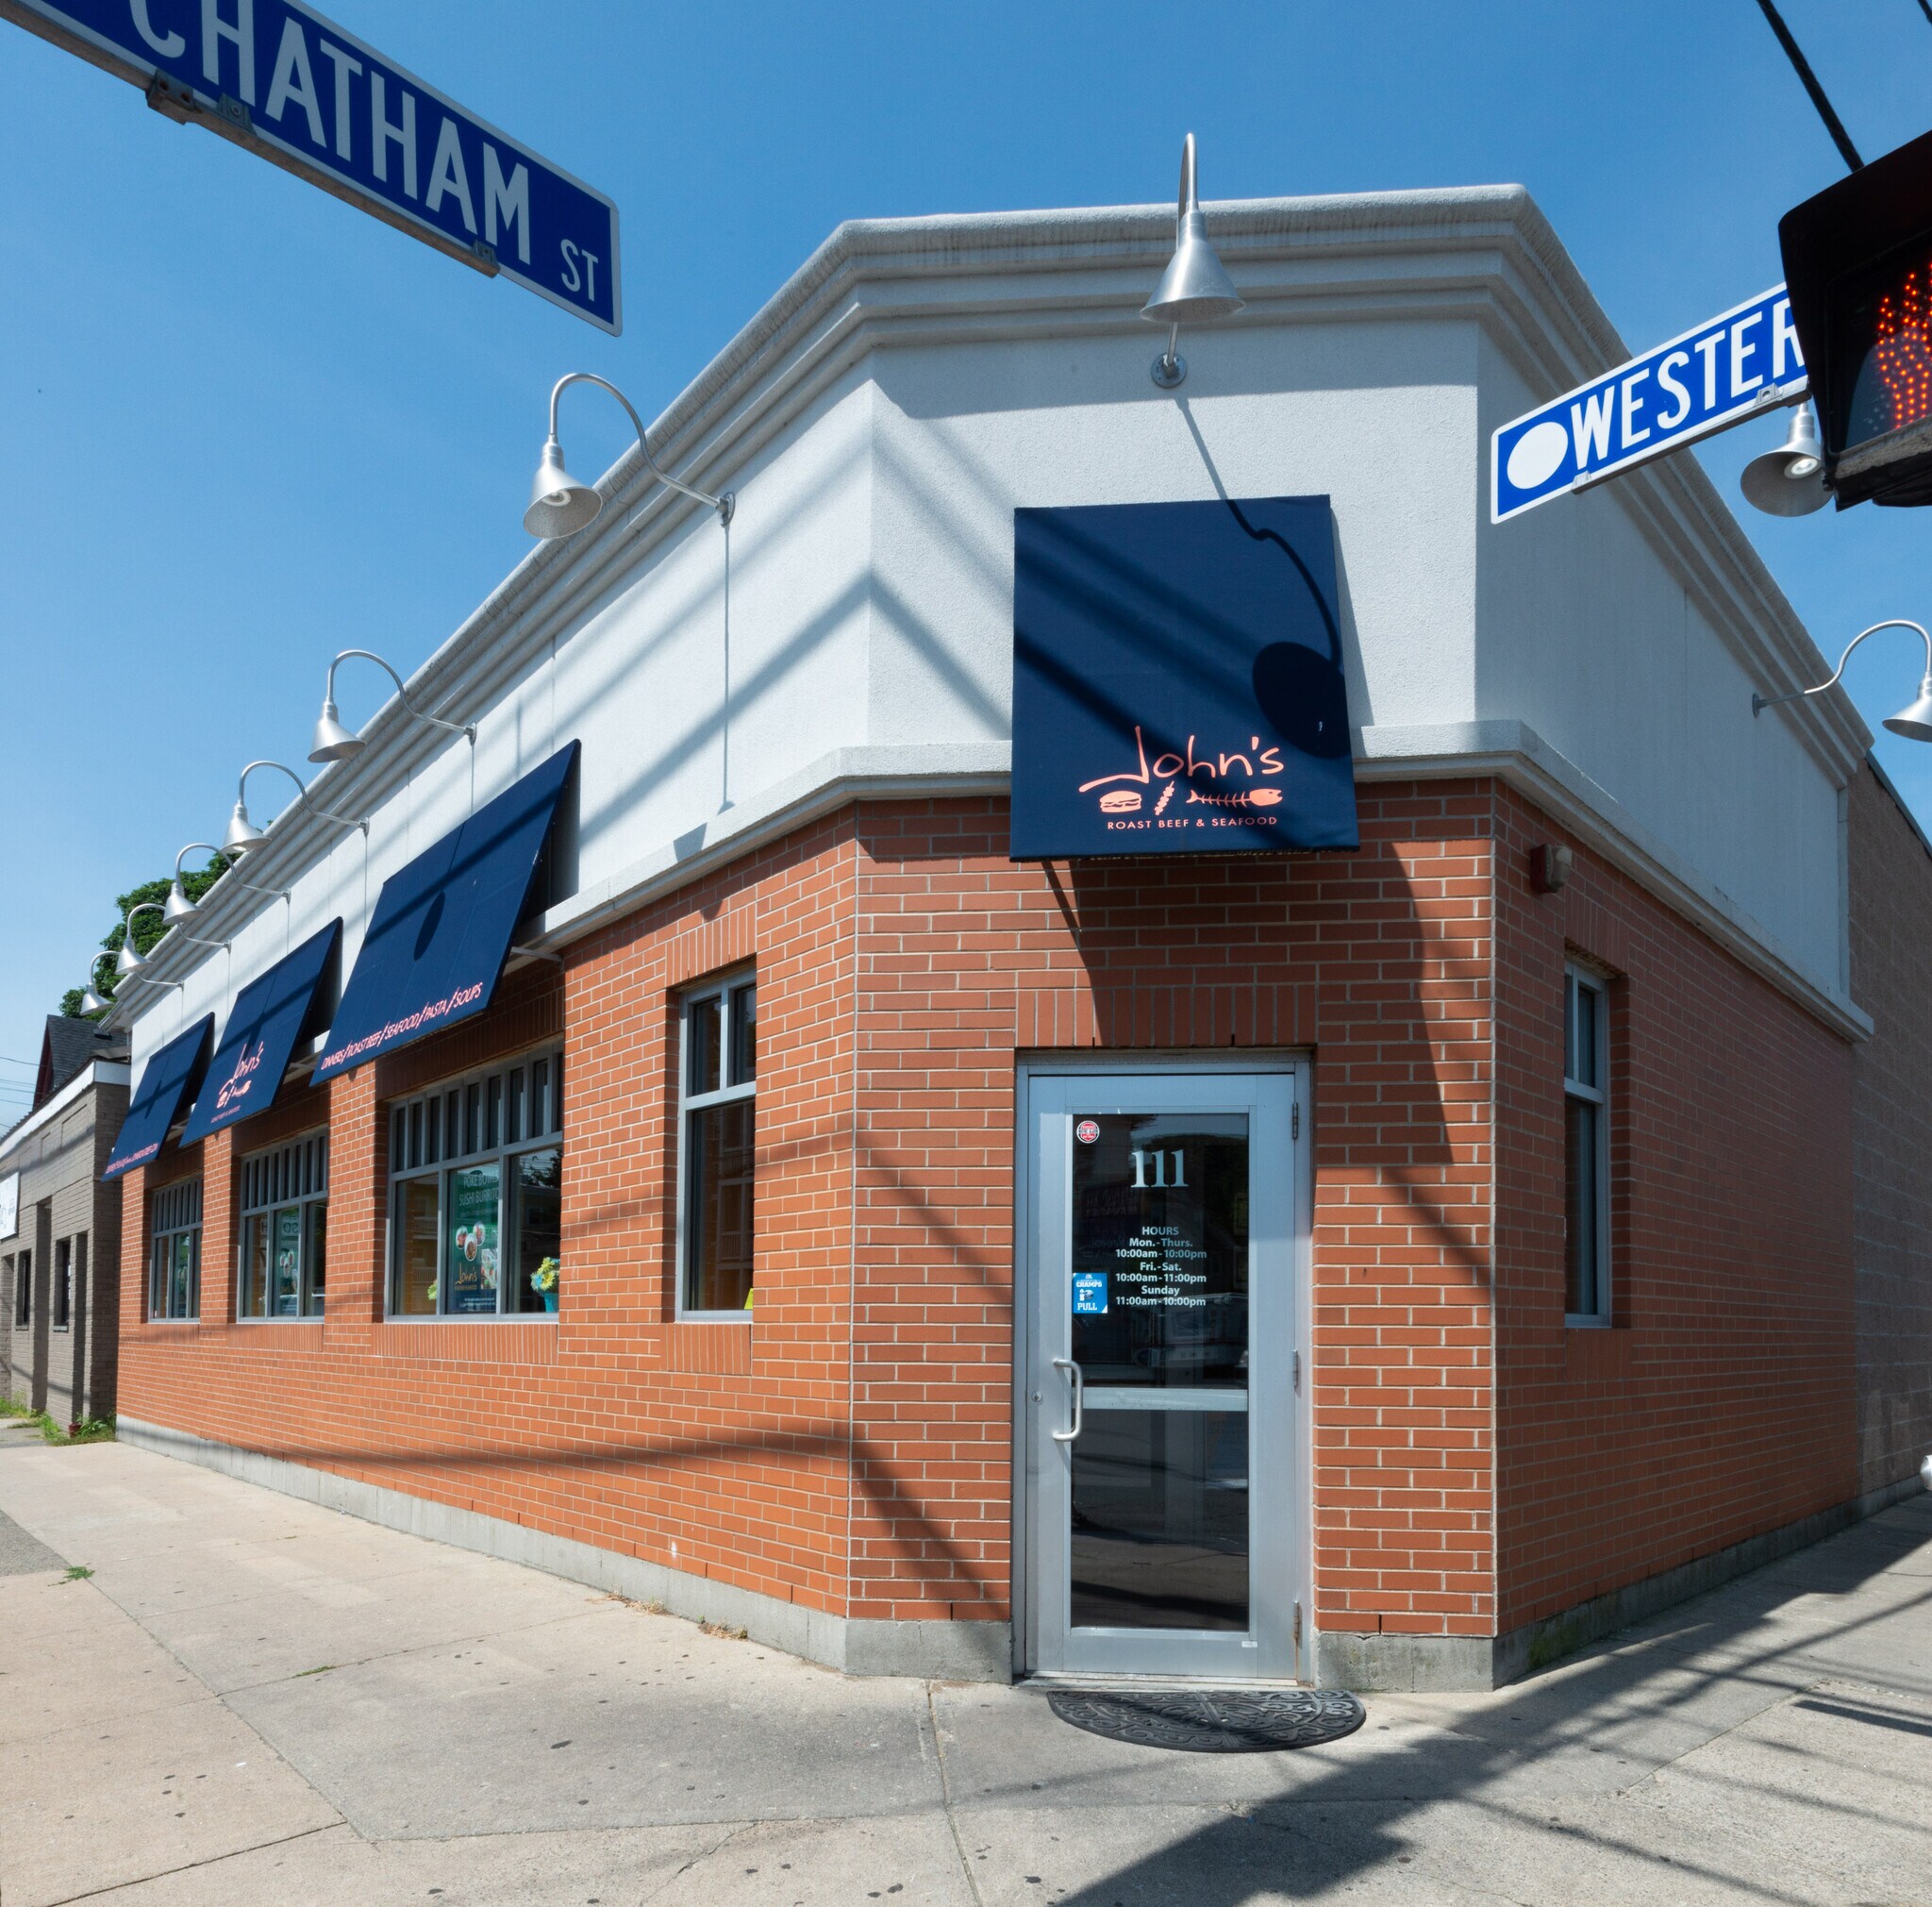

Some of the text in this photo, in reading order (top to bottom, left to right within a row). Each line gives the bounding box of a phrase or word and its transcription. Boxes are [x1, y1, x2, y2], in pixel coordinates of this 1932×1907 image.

[560, 239, 599, 301] ST
[1078, 725, 1285, 793] John's
[1108, 816, 1277, 830] ROAST BEEF & SEAFOOD
[1130, 1149, 1189, 1188] 111
[1141, 1227, 1179, 1236] HOURS
[1141, 1285, 1180, 1296] Sunday
[1077, 1302, 1098, 1311] PULL
